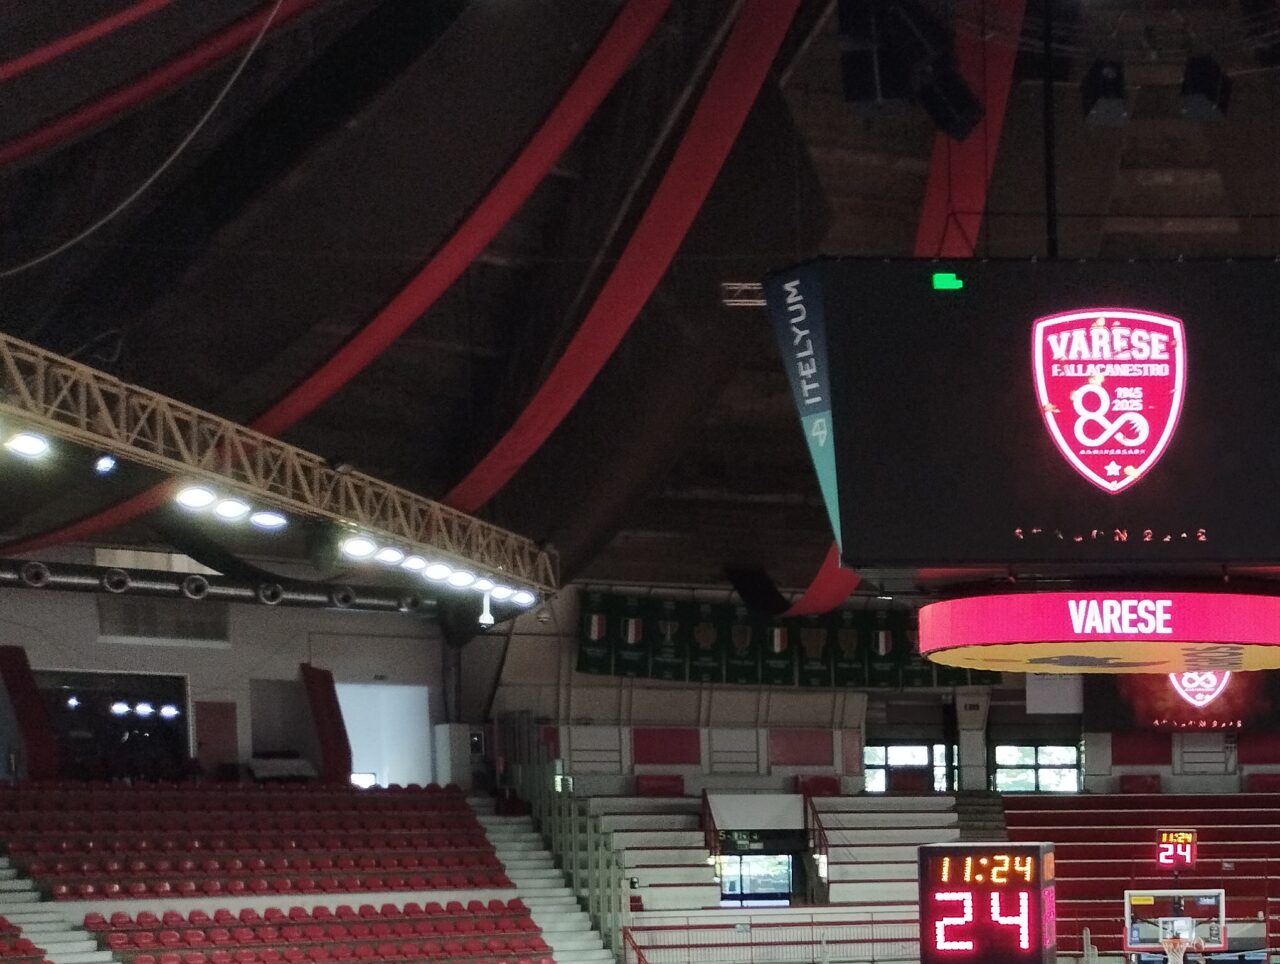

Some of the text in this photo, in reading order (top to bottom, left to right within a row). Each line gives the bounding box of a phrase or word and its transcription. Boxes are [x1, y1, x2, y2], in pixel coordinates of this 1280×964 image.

[784, 279, 822, 406] ITELYUM
[1047, 327, 1169, 361] VARESE
[1068, 599, 1173, 634] VARESE
[1159, 844, 1191, 863] 24
[1162, 832, 1192, 843] 11:24
[940, 855, 1033, 883] 11:24
[934, 891, 1029, 950] 24
